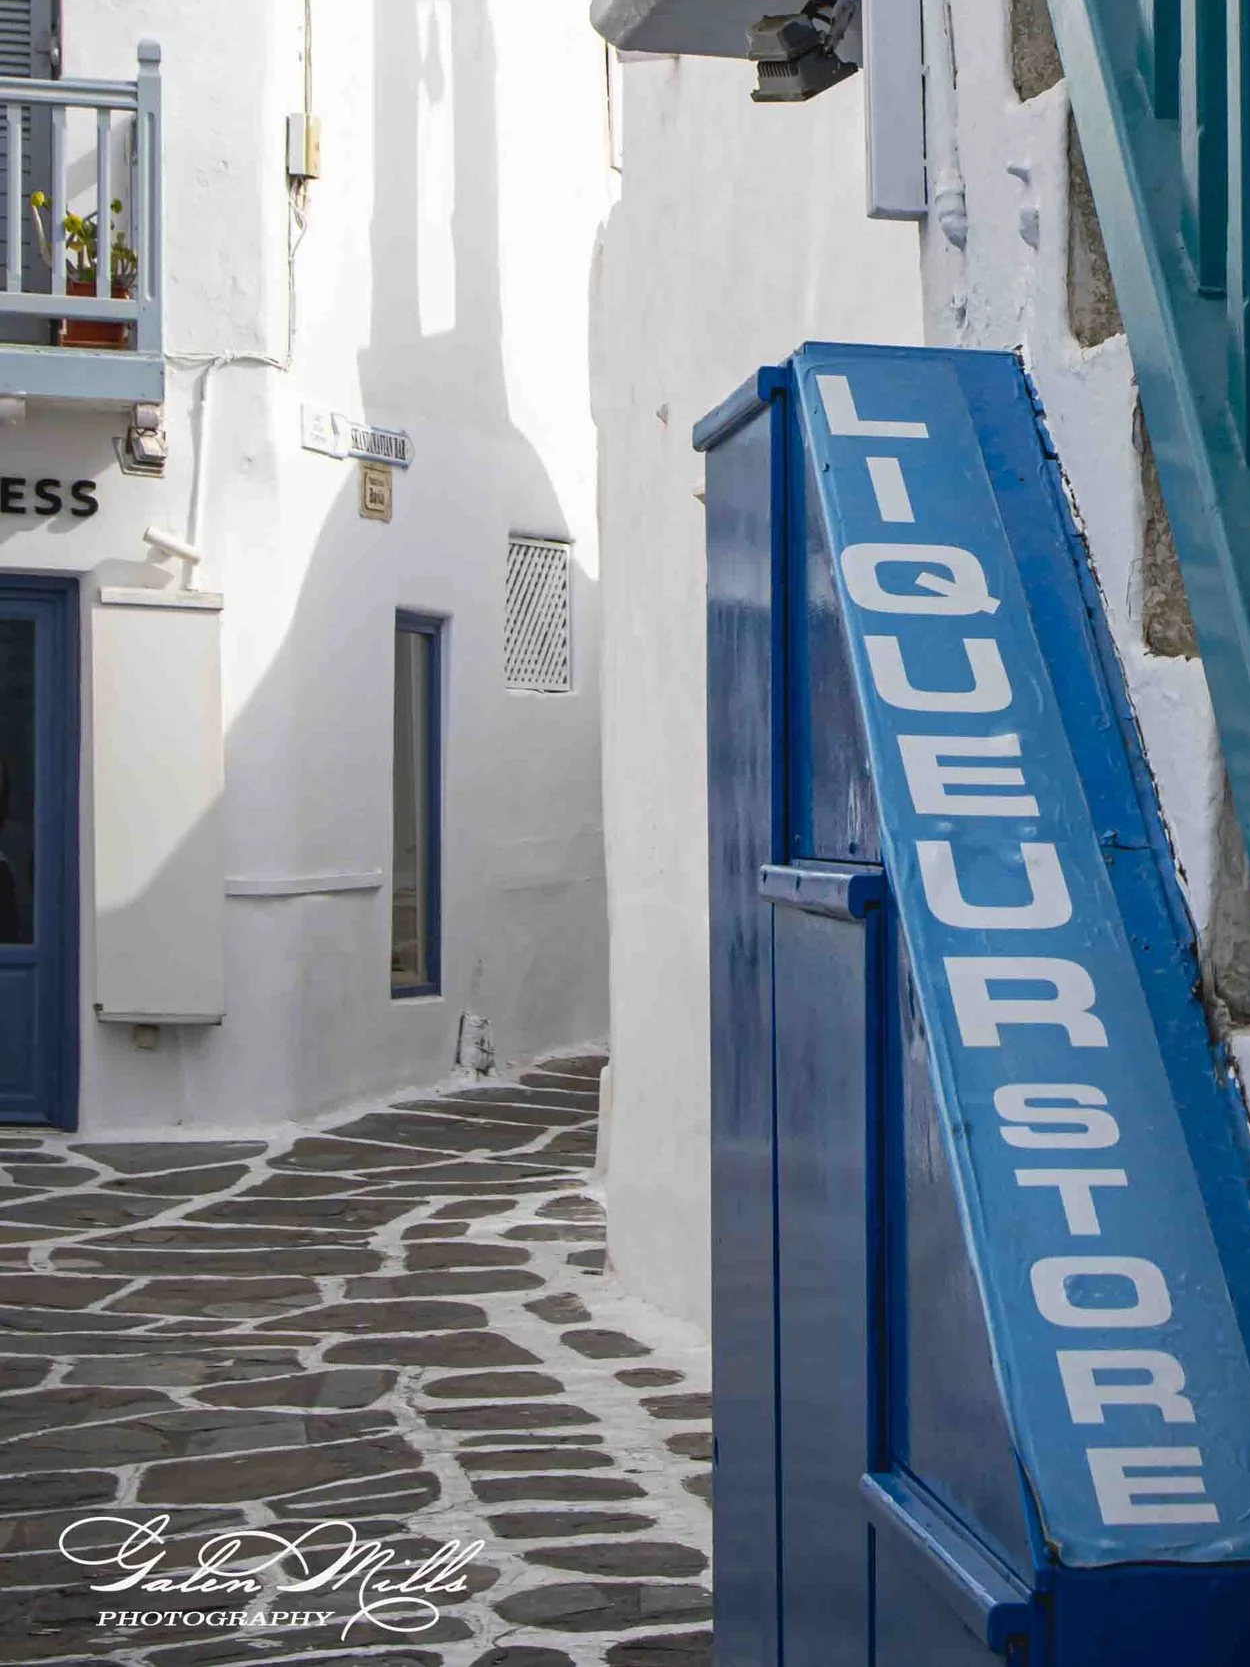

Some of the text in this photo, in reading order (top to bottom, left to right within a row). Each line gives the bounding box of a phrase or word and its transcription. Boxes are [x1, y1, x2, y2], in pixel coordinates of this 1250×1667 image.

[0, 477, 99, 517] ESS
[816, 374, 1219, 1526] LIQUEUR STORE
